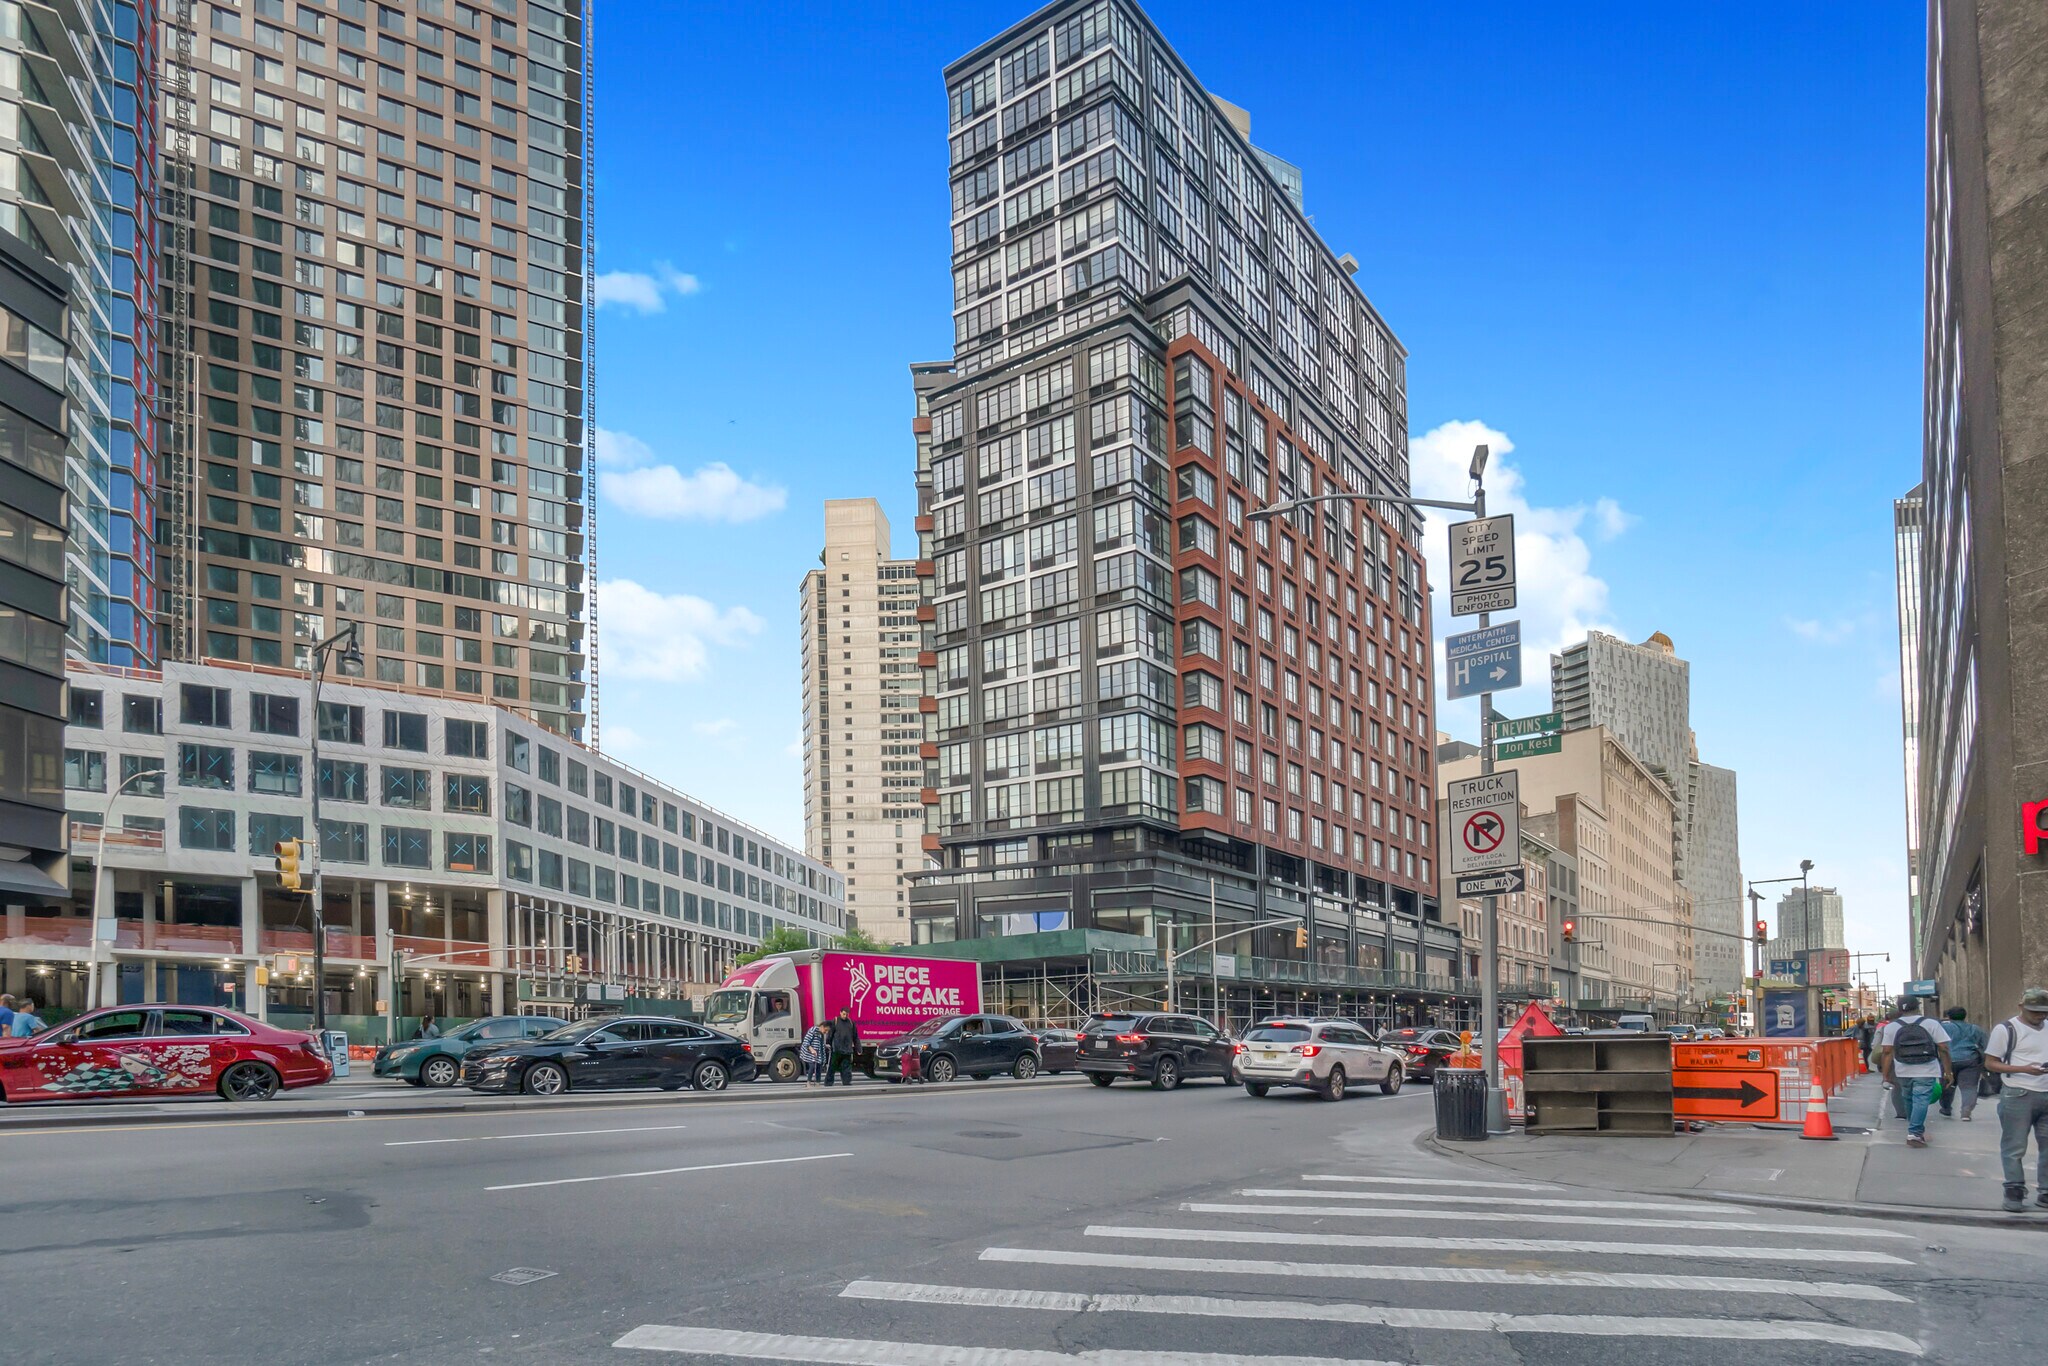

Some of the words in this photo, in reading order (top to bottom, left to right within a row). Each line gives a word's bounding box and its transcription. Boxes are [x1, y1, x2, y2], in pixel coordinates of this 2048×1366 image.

[1466, 522, 1494, 534] CITY
[1462, 532, 1499, 546] SPEED
[1466, 543, 1496, 556] LIMIT
[1459, 555, 1508, 586] 25
[1466, 592, 1500, 603] PHOTO
[1457, 599, 1511, 613] ENFORCED
[1458, 627, 1507, 644] INTERFAITH
[1450, 641, 1483, 655] MEDICAL
[1486, 634, 1516, 648] CENTER
[1609, 638, 1637, 651] ASHLAND
[1502, 718, 1542, 736] NEVINS
[1546, 716, 1556, 724] ST
[1504, 742, 1524, 754] Jon
[1528, 738, 1553, 750] Kest
[1461, 777, 1504, 795] TRUCK
[1452, 790, 1515, 810] RESTRICTION
[1462, 855, 1485, 863] EXCEPT
[1486, 852, 1507, 860] LOCAL
[1466, 859, 1502, 869] DELIVERIES
[1465, 881, 1486, 892] ONE
[1494, 877, 1515, 888] WAY
[874, 964, 930, 985] PIECE
[875, 985, 904, 1004] OF
[876, 1006, 913, 1015] MOVING
[914, 1007, 921, 1015] &
[922, 1007, 961, 1016] STORAGE
[1680, 1047, 1691, 1055] USE
[1694, 1047, 1734, 1055] TEMPORARY
[1690, 1058, 1724, 1066] WALKWAY
